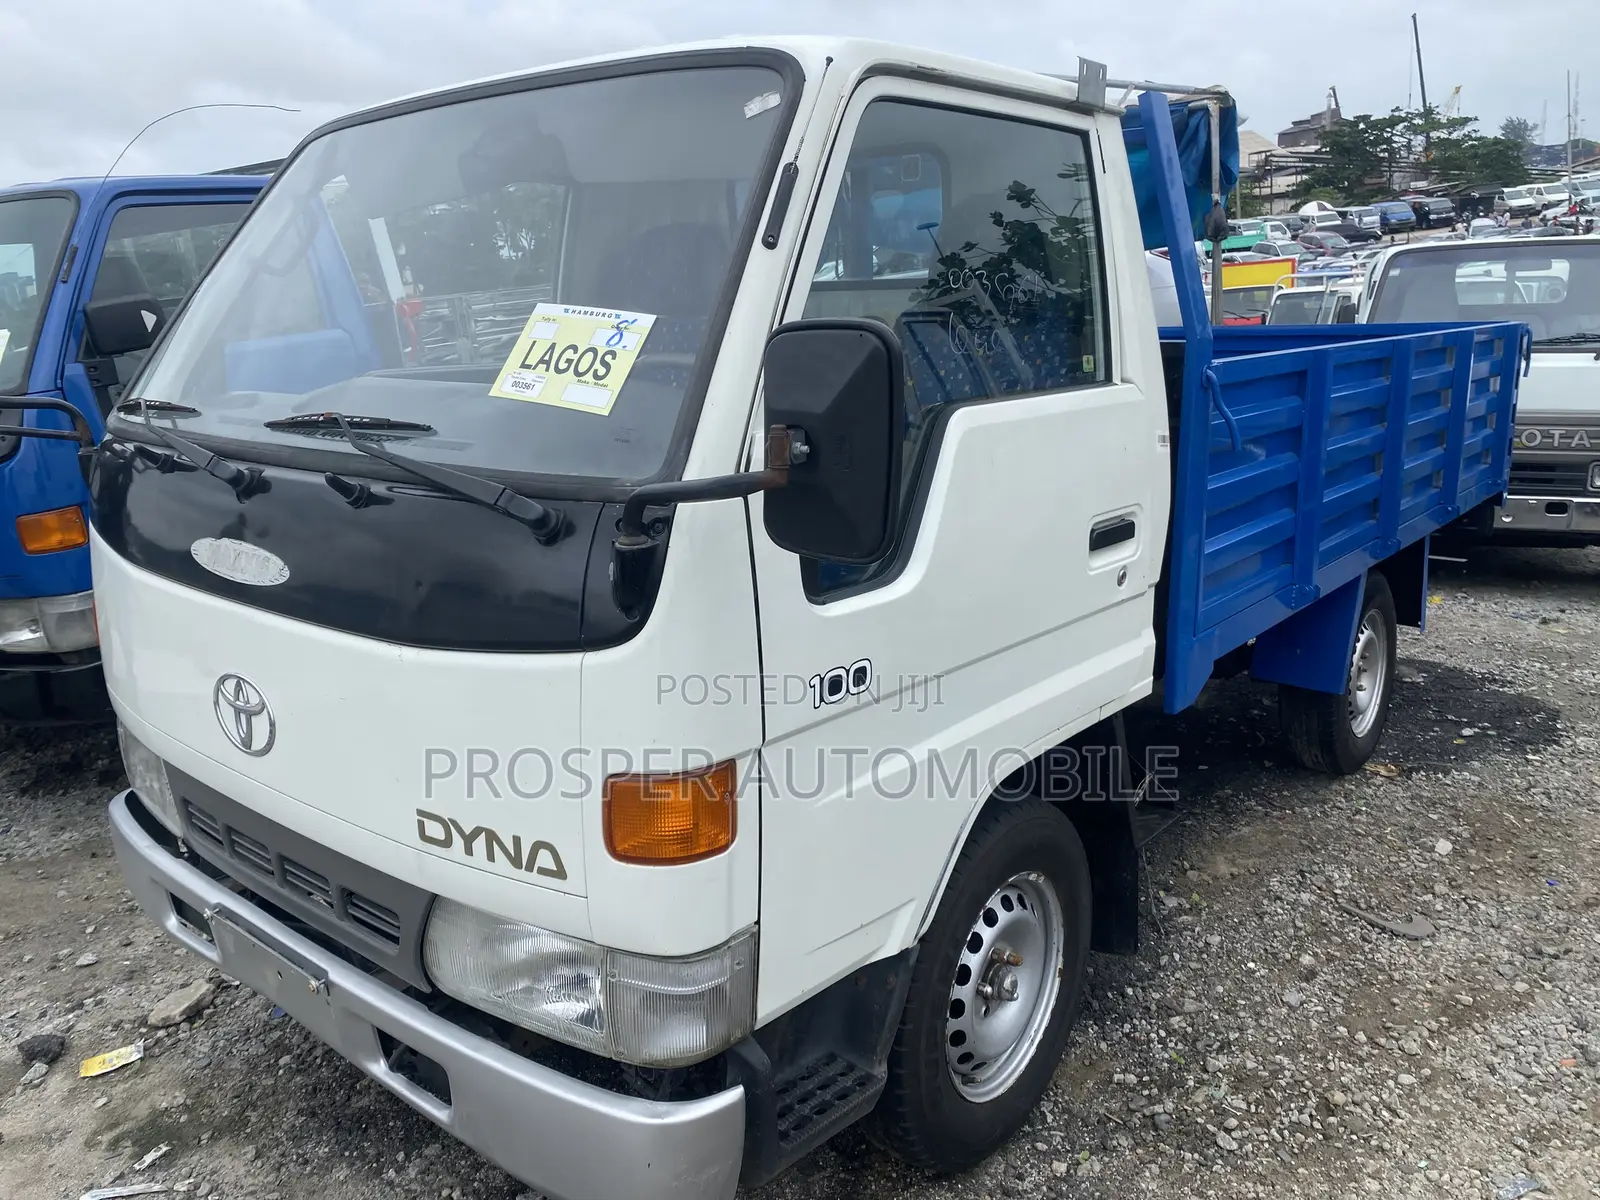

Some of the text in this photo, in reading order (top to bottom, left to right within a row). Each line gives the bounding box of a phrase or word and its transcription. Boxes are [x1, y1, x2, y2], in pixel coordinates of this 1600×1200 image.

[570, 309, 612, 318] HAMBURG
[519, 340, 617, 381] LAGOS
[511, 380, 535, 390] 003561
[1521, 428, 1591, 448] OTA
[809, 658, 872, 710] 100
[416, 808, 567, 880] DYNA
